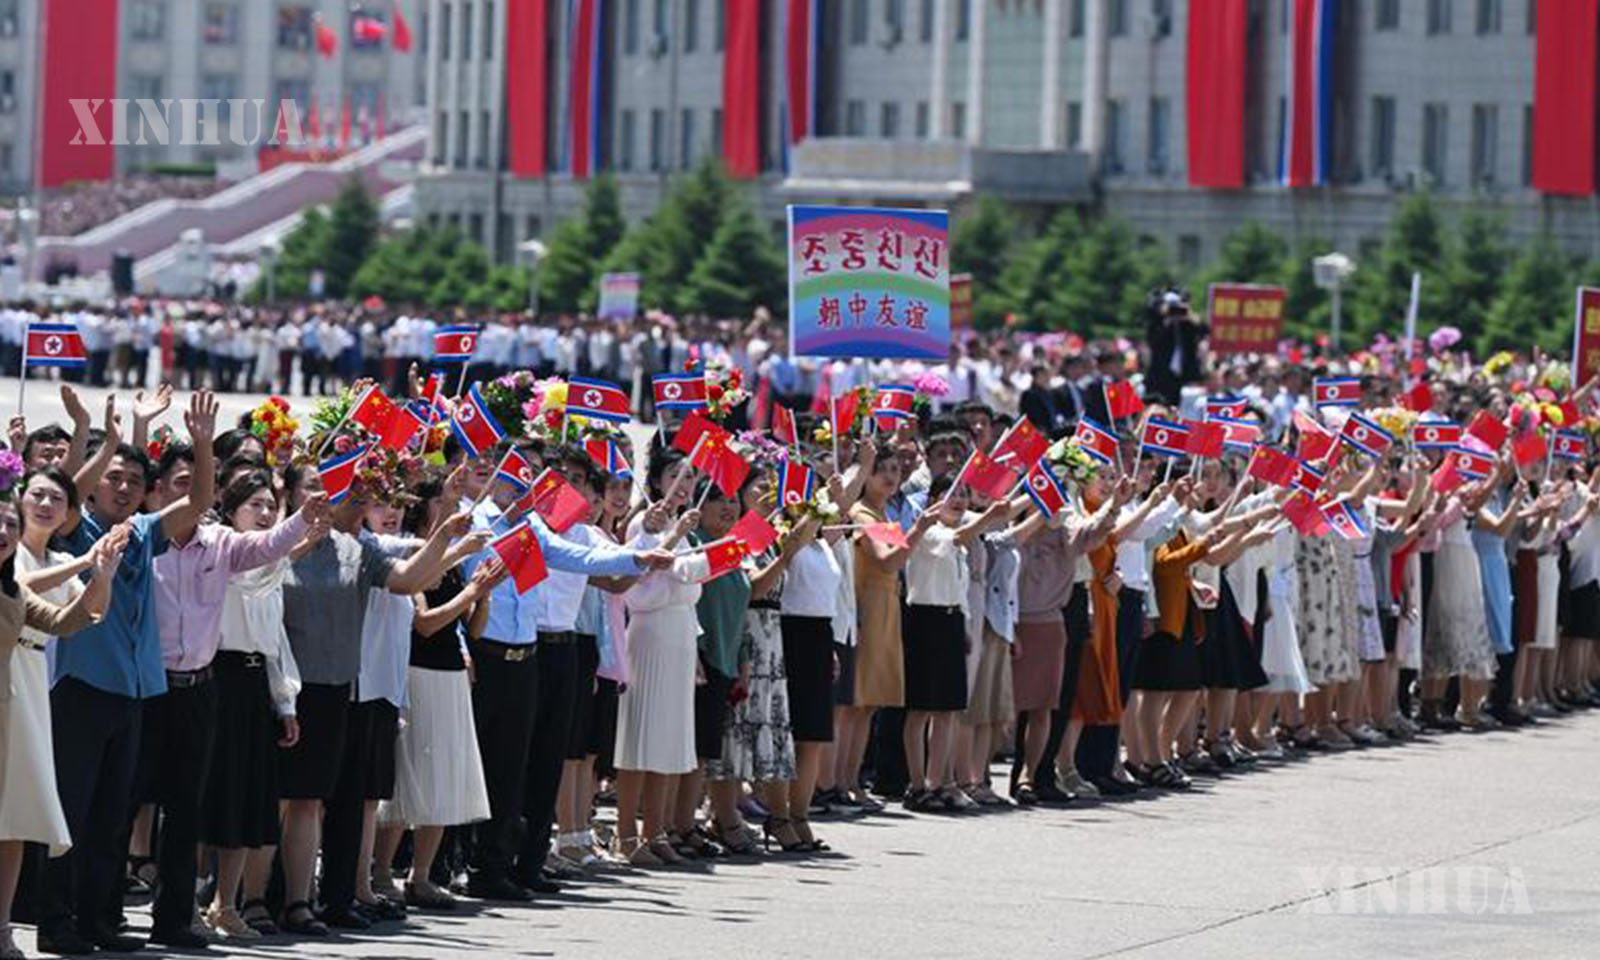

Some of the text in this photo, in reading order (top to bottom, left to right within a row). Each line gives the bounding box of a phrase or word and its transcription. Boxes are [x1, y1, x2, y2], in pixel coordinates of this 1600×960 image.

[802, 230, 940, 279] 조중친선
[817, 292, 929, 329] 朝中友谊
